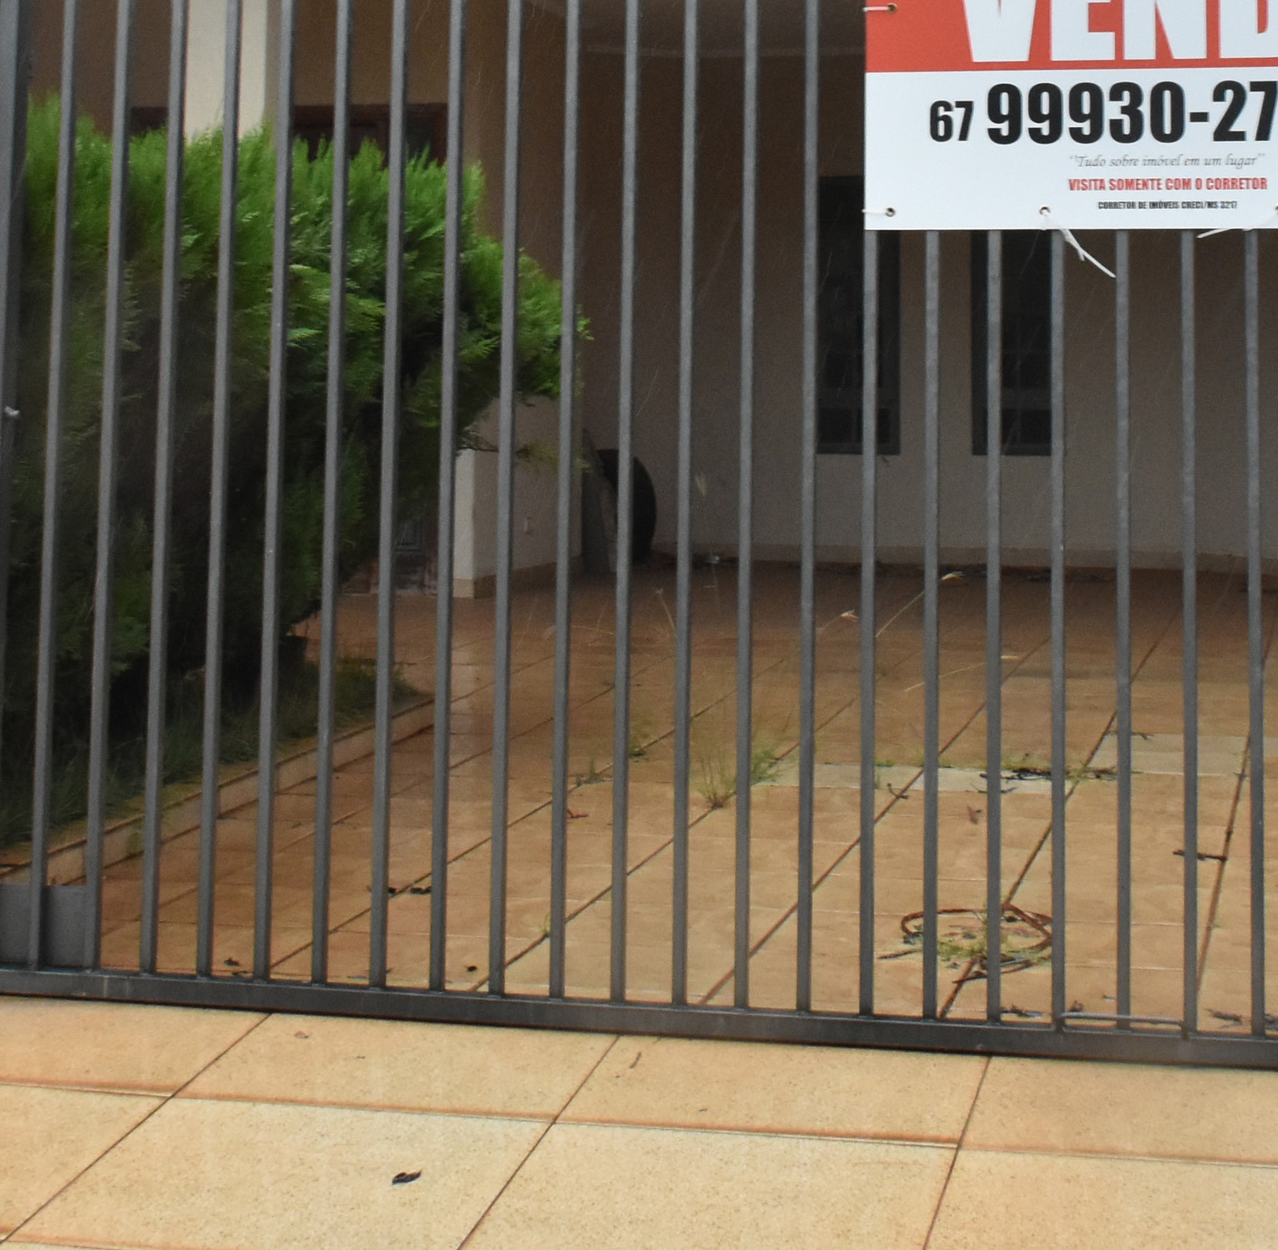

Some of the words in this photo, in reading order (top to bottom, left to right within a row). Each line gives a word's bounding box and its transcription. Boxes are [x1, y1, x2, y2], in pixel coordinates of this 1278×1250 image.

[929, 99, 973, 143] 67
[1110, 154, 1138, 167] sobre
[1142, 153, 1182, 167] imóvel
[1185, 157, 1200, 167] em
[1204, 157, 1222, 166] um
[1068, 178, 1106, 191] VISITA
[1109, 178, 1162, 191] SOMENTE
[1166, 178, 1192, 190] COM
[1195, 178, 1202, 190] O
[1206, 177, 1267, 190] CORRETOR
[1098, 201, 1136, 209] CORRETOR
[1138, 201, 1148, 209] DE
[1149, 199, 1179, 209] IMÓVEIS
